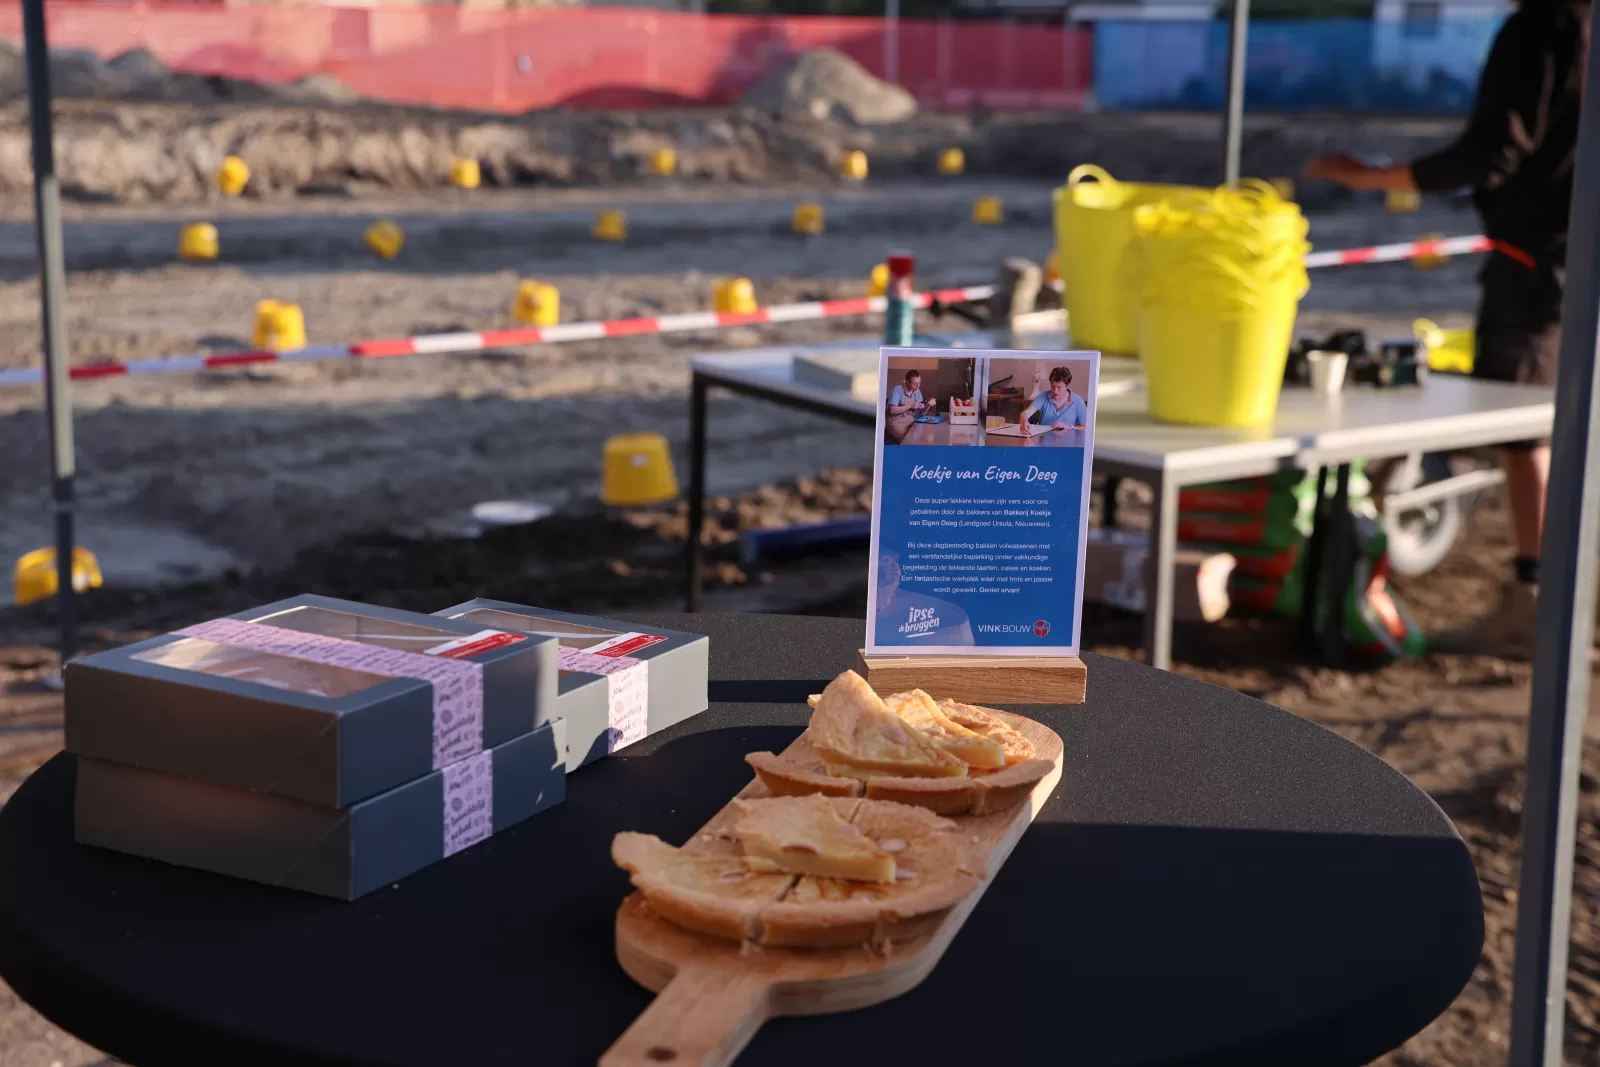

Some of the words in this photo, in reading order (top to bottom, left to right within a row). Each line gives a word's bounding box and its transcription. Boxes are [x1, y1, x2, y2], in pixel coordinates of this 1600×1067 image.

[911, 464, 952, 483] Koekje
[956, 470, 980, 480] van
[984, 465, 1021, 484] Eigen
[1025, 465, 1058, 484] Deeg
[1003, 509, 1029, 517] Bakkerij
[1030, 509, 1052, 517] Koekje
[958, 520, 991, 528] (Landgoed
[907, 541, 916, 549] Bij
[933, 542, 974, 550] dagbesteding
[921, 553, 963, 561] verstandelijke
[963, 553, 994, 561] beperking
[903, 564, 938, 572] begeleiding
[908, 606, 935, 624] ipse
[904, 617, 940, 633] bruggen
[977, 624, 1001, 633] VINK
[1002, 624, 1031, 633] BOUW
